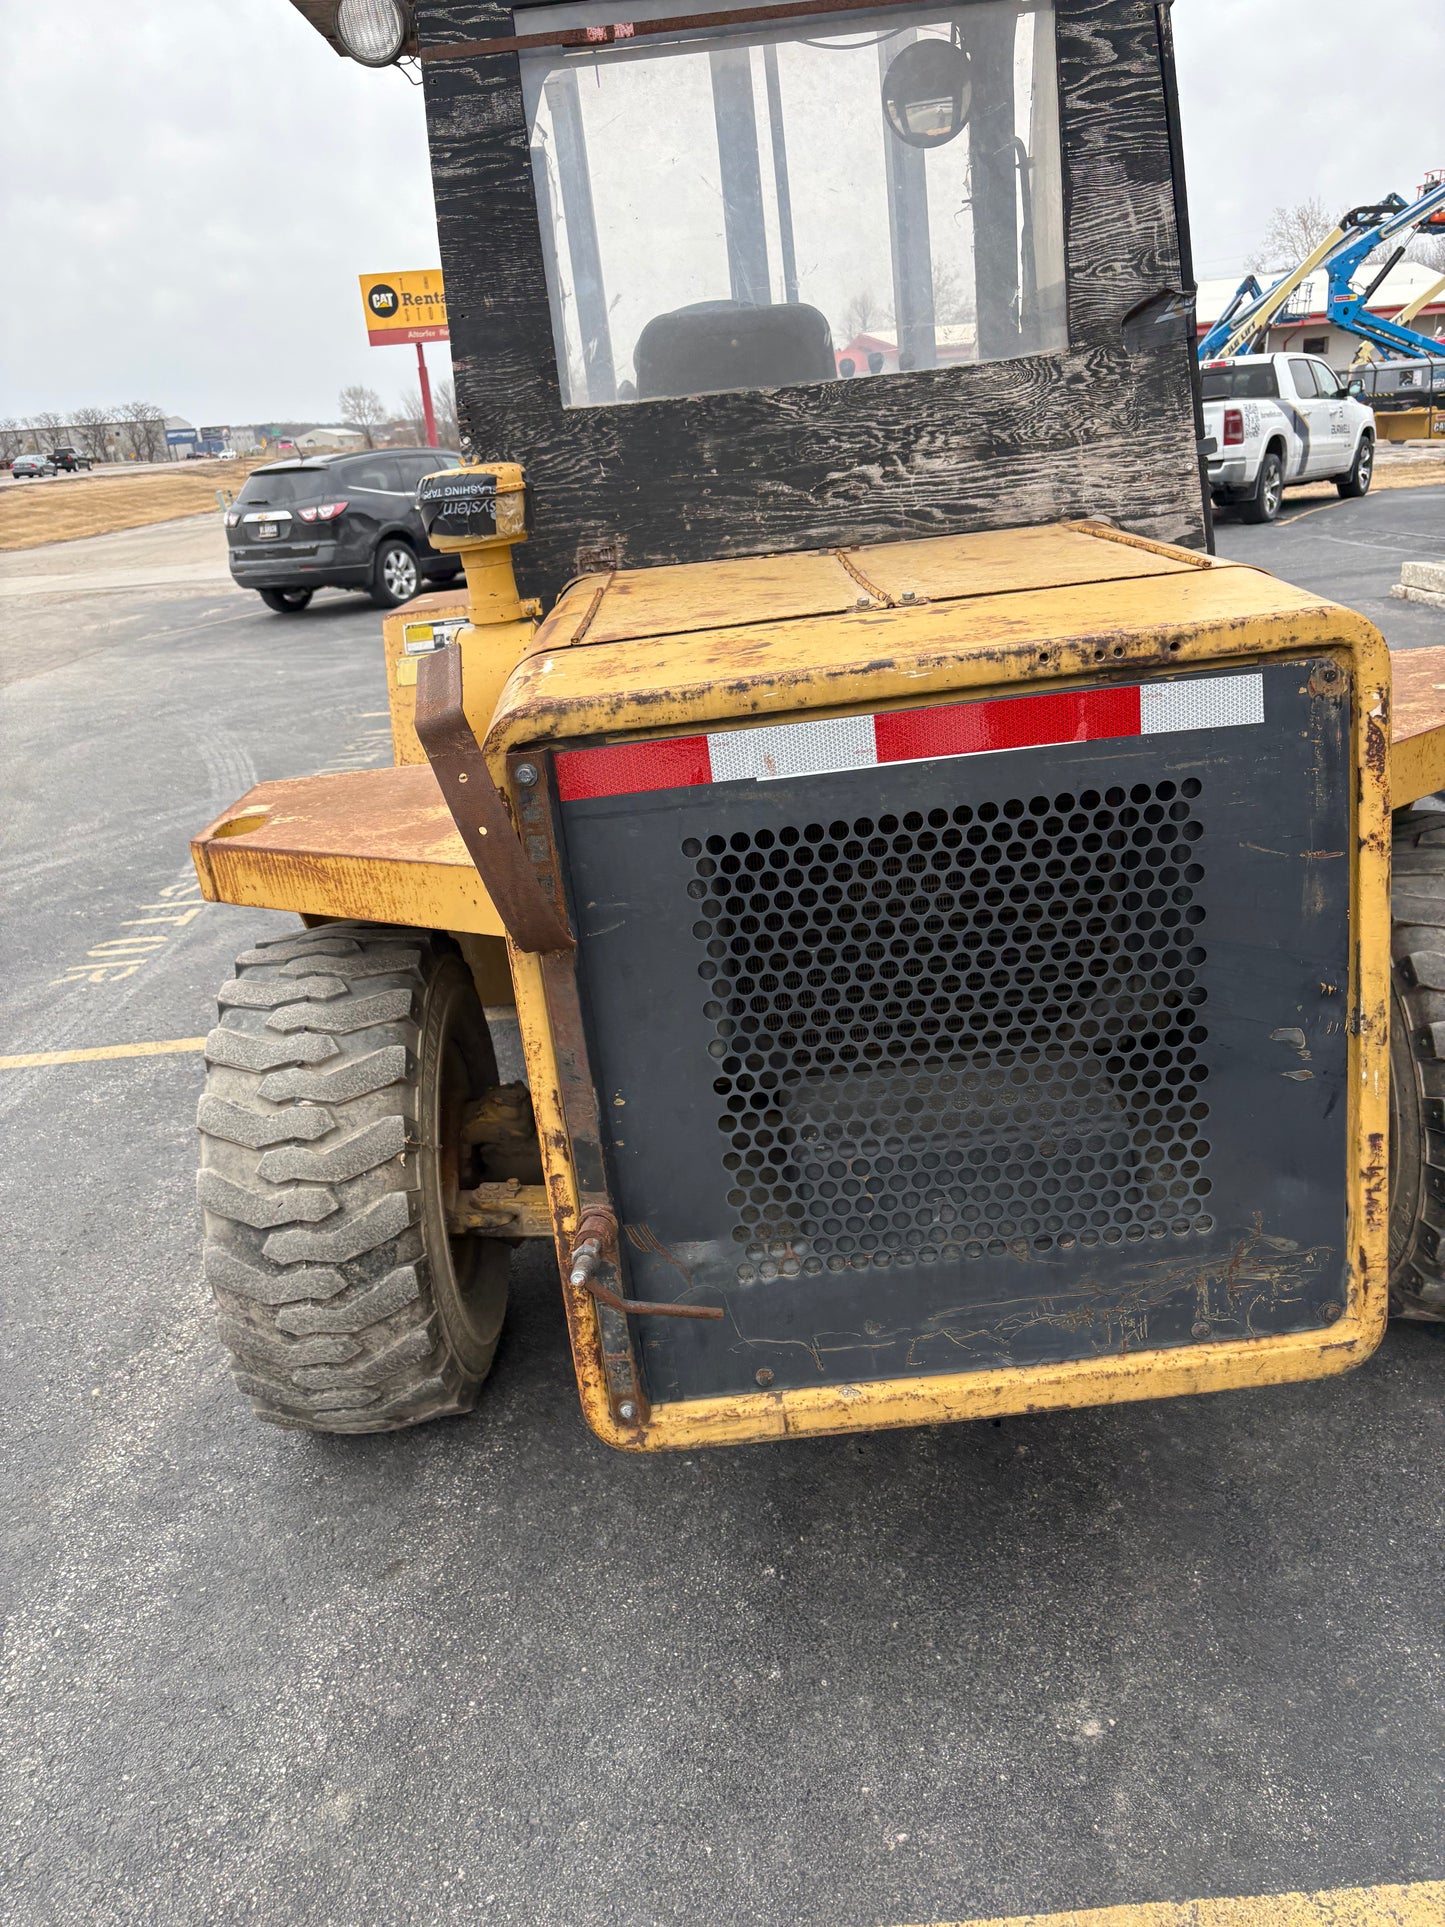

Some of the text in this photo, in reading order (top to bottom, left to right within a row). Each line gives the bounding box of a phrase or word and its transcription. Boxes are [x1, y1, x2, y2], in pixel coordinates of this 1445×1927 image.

[371, 293, 394, 309] CAT
[401, 292, 446, 306] Renta
[1434, 422, 1445, 433] CA
